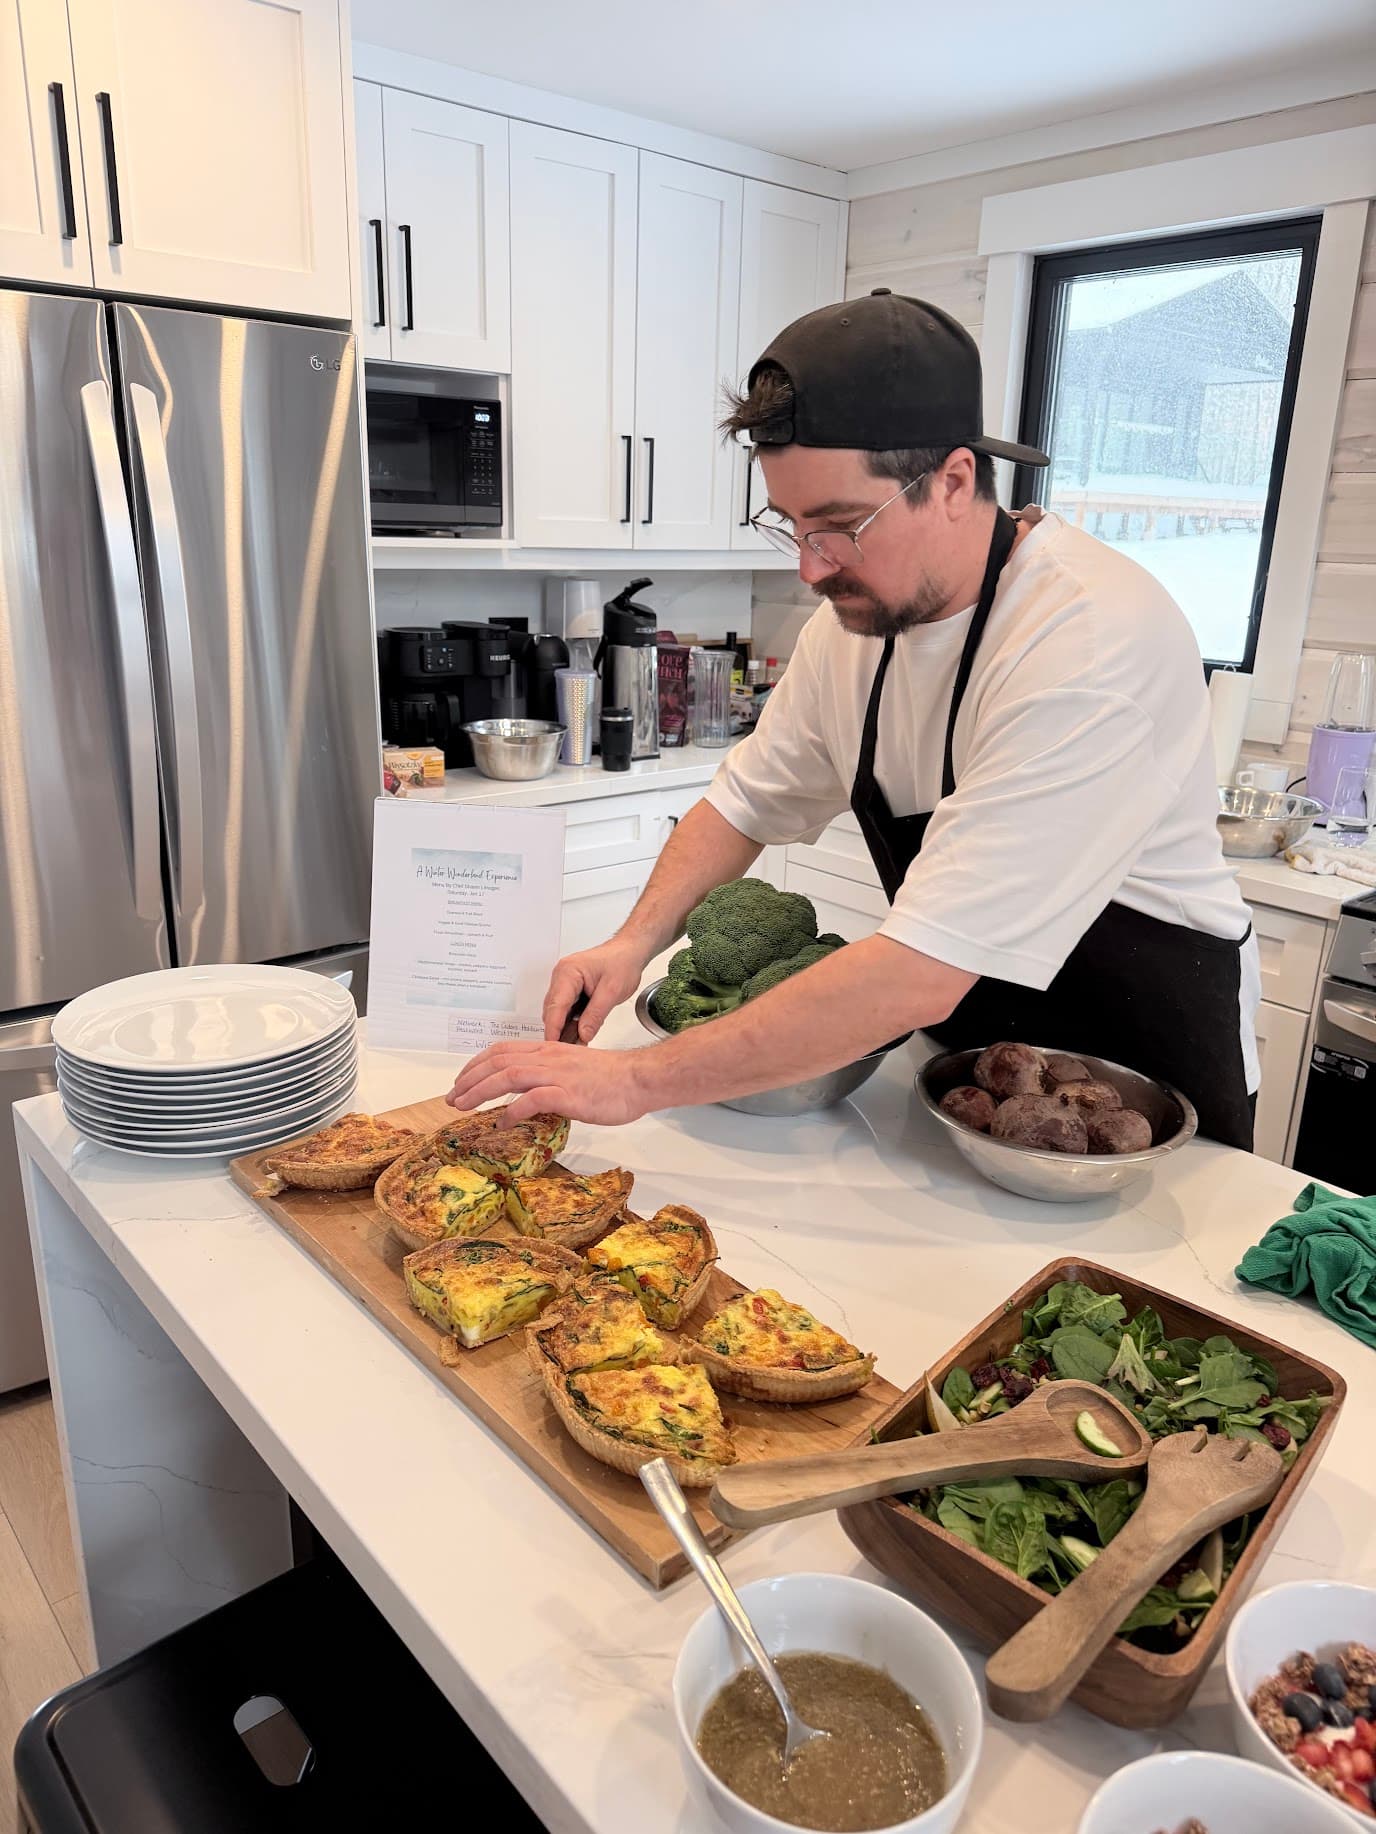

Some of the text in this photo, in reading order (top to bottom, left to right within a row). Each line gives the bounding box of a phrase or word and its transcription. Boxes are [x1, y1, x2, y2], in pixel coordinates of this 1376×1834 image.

[416, 864, 518, 884] A Winter Wonderland Experience
